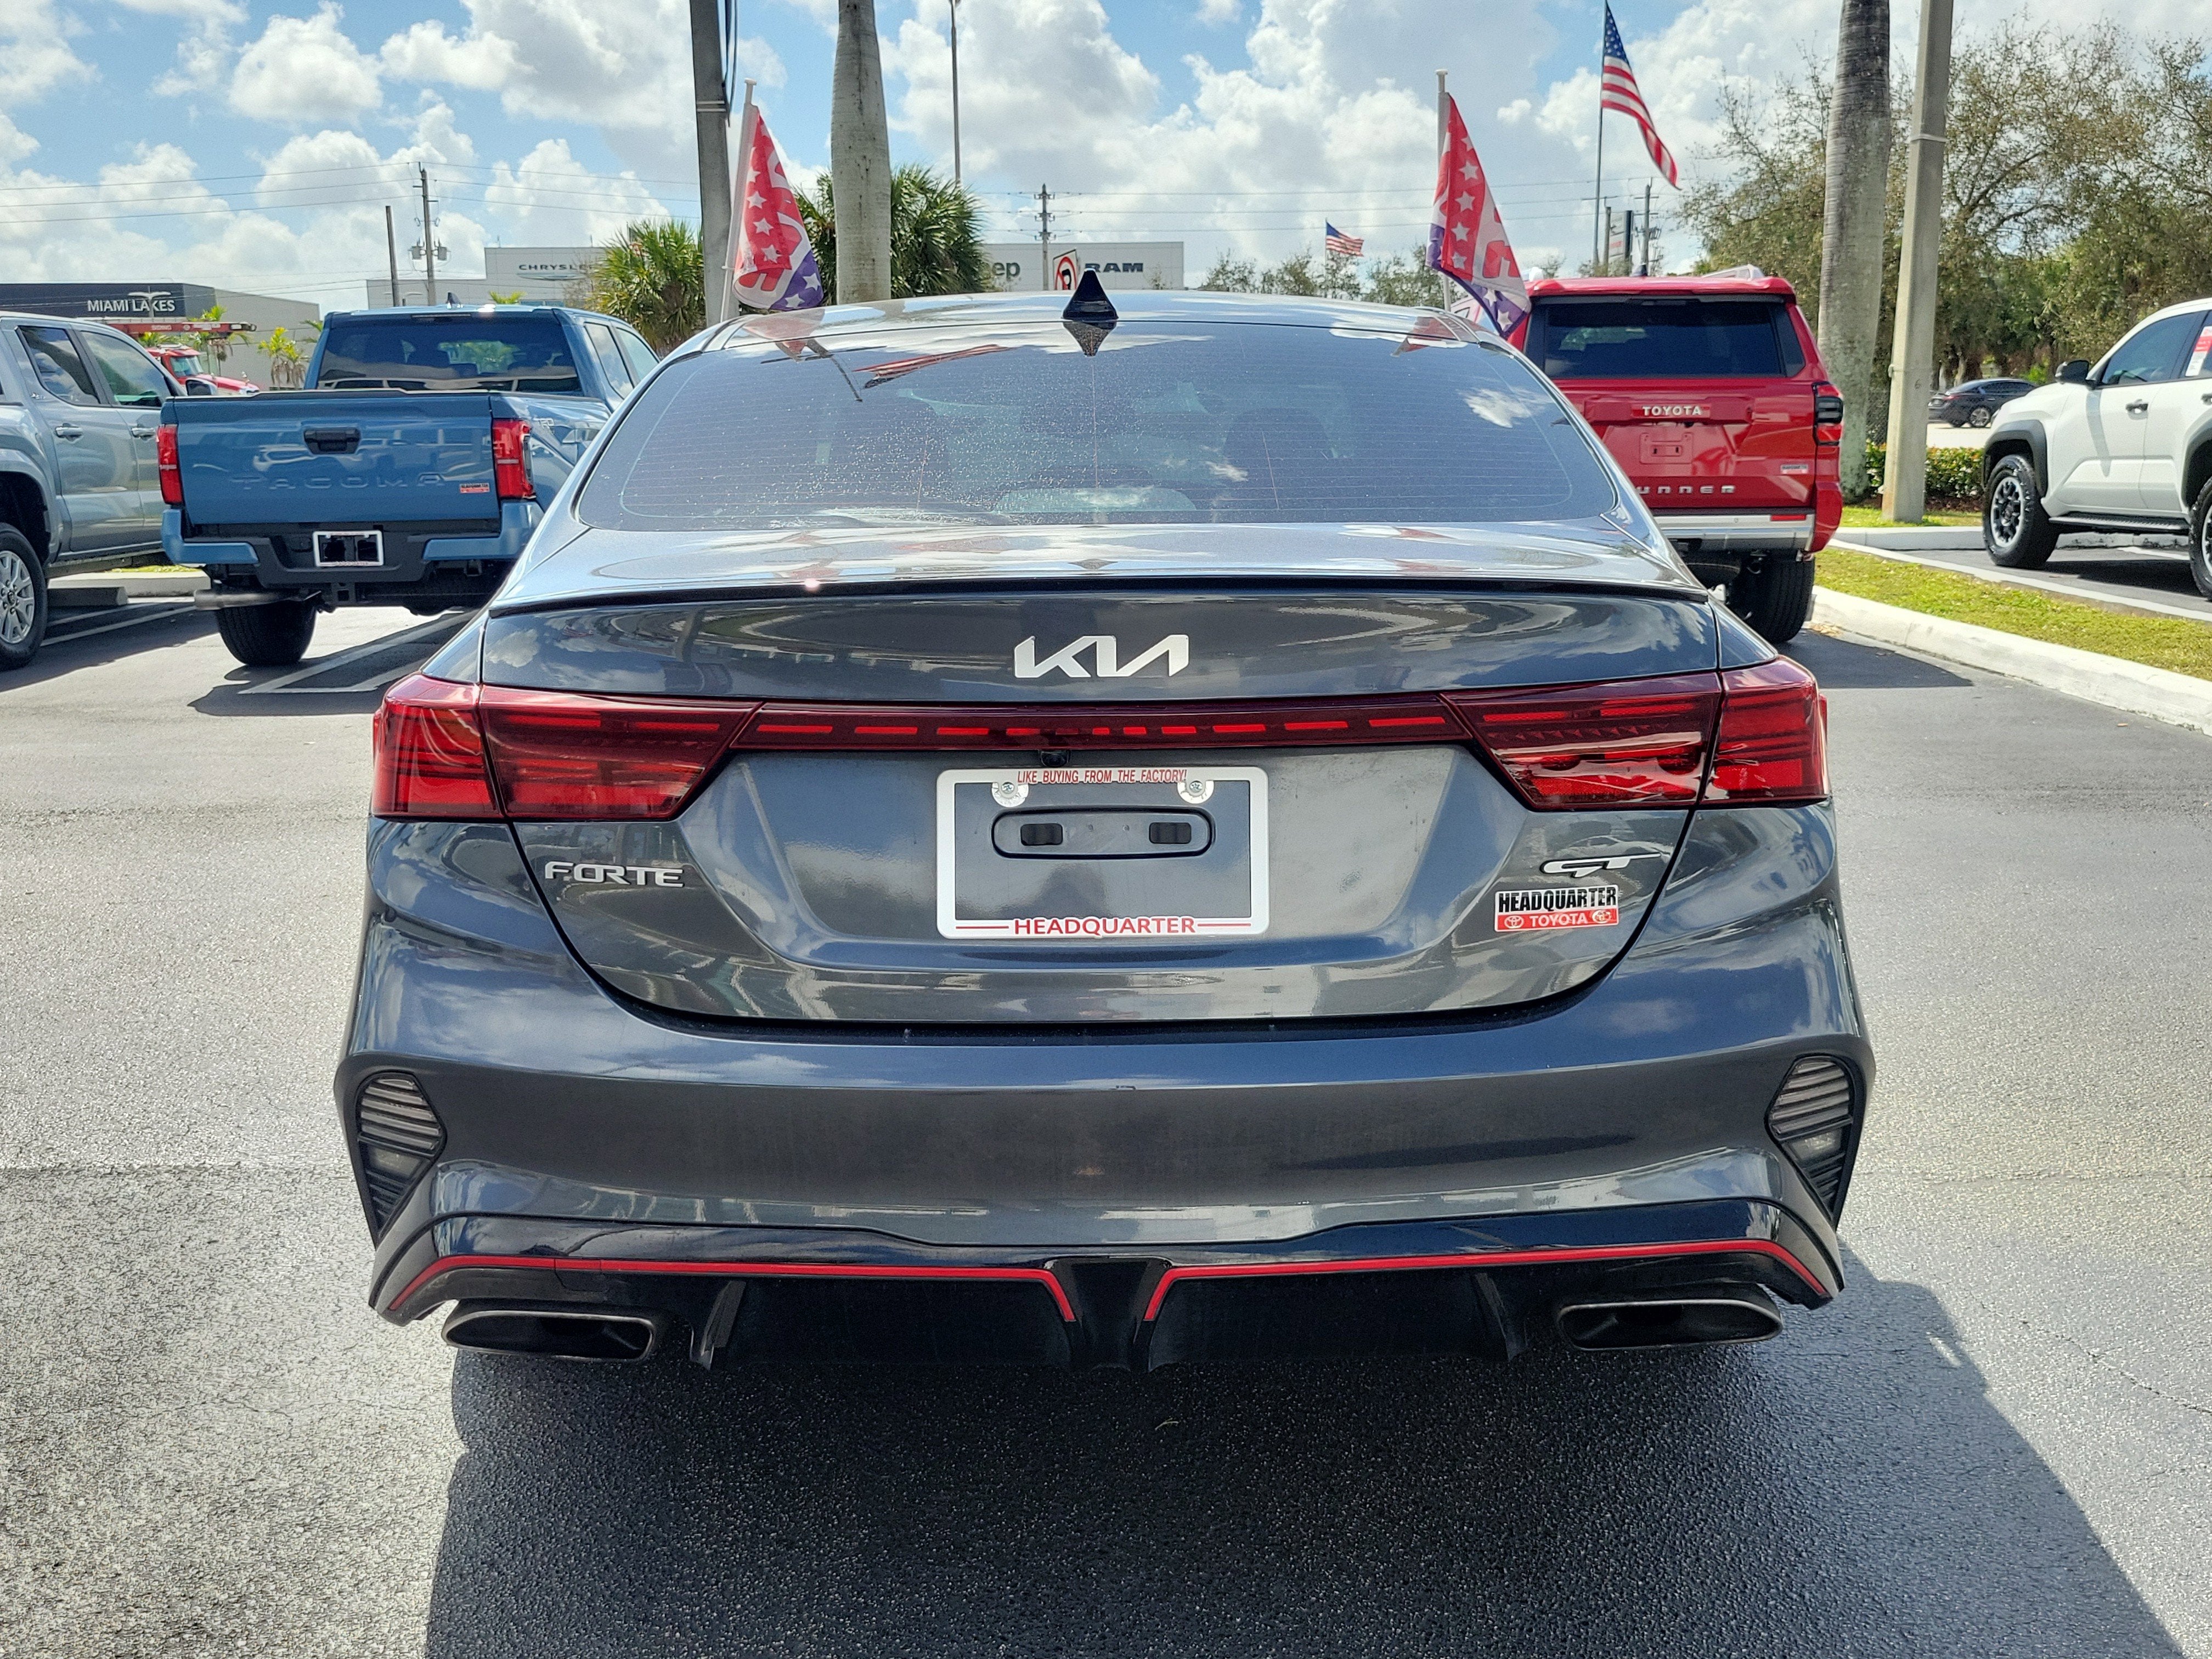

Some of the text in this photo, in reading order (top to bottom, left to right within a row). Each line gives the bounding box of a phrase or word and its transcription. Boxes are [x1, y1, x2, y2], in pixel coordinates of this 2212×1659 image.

[991, 262, 1020, 282] ep
[1085, 263, 1143, 273] RAM
[88, 300, 175, 312] MIAMI LAKES
[1643, 405, 1701, 416] TOYOTA
[533, 417, 555, 429] TRD
[229, 473, 446, 490] TACOMA
[1014, 634, 1189, 678] KIA
[1017, 769, 1187, 783] LIKE BUYING FROM THE FACTORY!
[1540, 853, 1661, 878] GT
[545, 861, 684, 888] FORTE
[1498, 886, 1617, 913] HEADQUARTER
[1014, 917, 1197, 936] HEADQUARTER
[1530, 912, 1588, 928] TOYOTA
